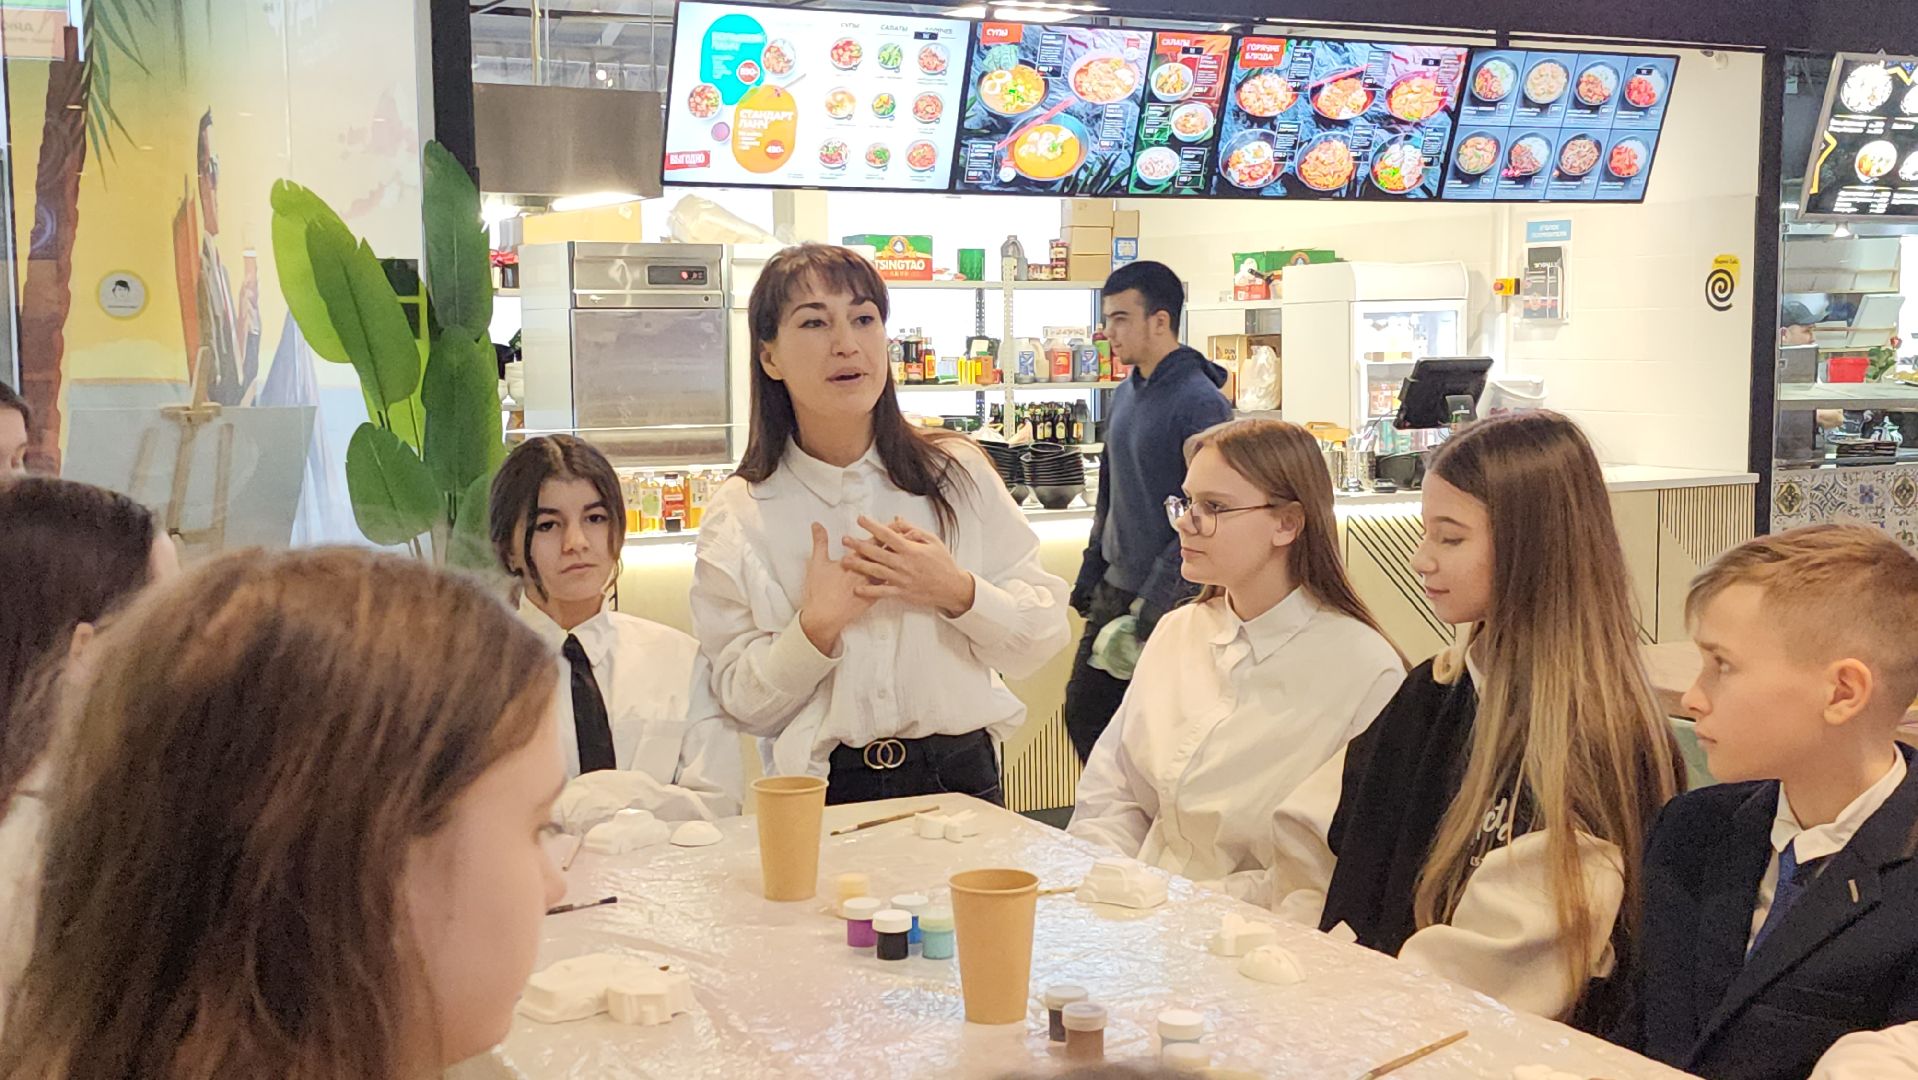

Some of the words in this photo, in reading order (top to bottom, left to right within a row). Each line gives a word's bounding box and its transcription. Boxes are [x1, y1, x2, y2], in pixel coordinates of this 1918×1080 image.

[986, 28, 1009, 37] СУПЫ
[1244, 52, 1274, 61] БЛЮДА
[739, 109, 794, 121] СТАНДАРТ
[669, 153, 706, 165] ВЫГОДНО
[874, 259, 926, 271] TSINGTAO
